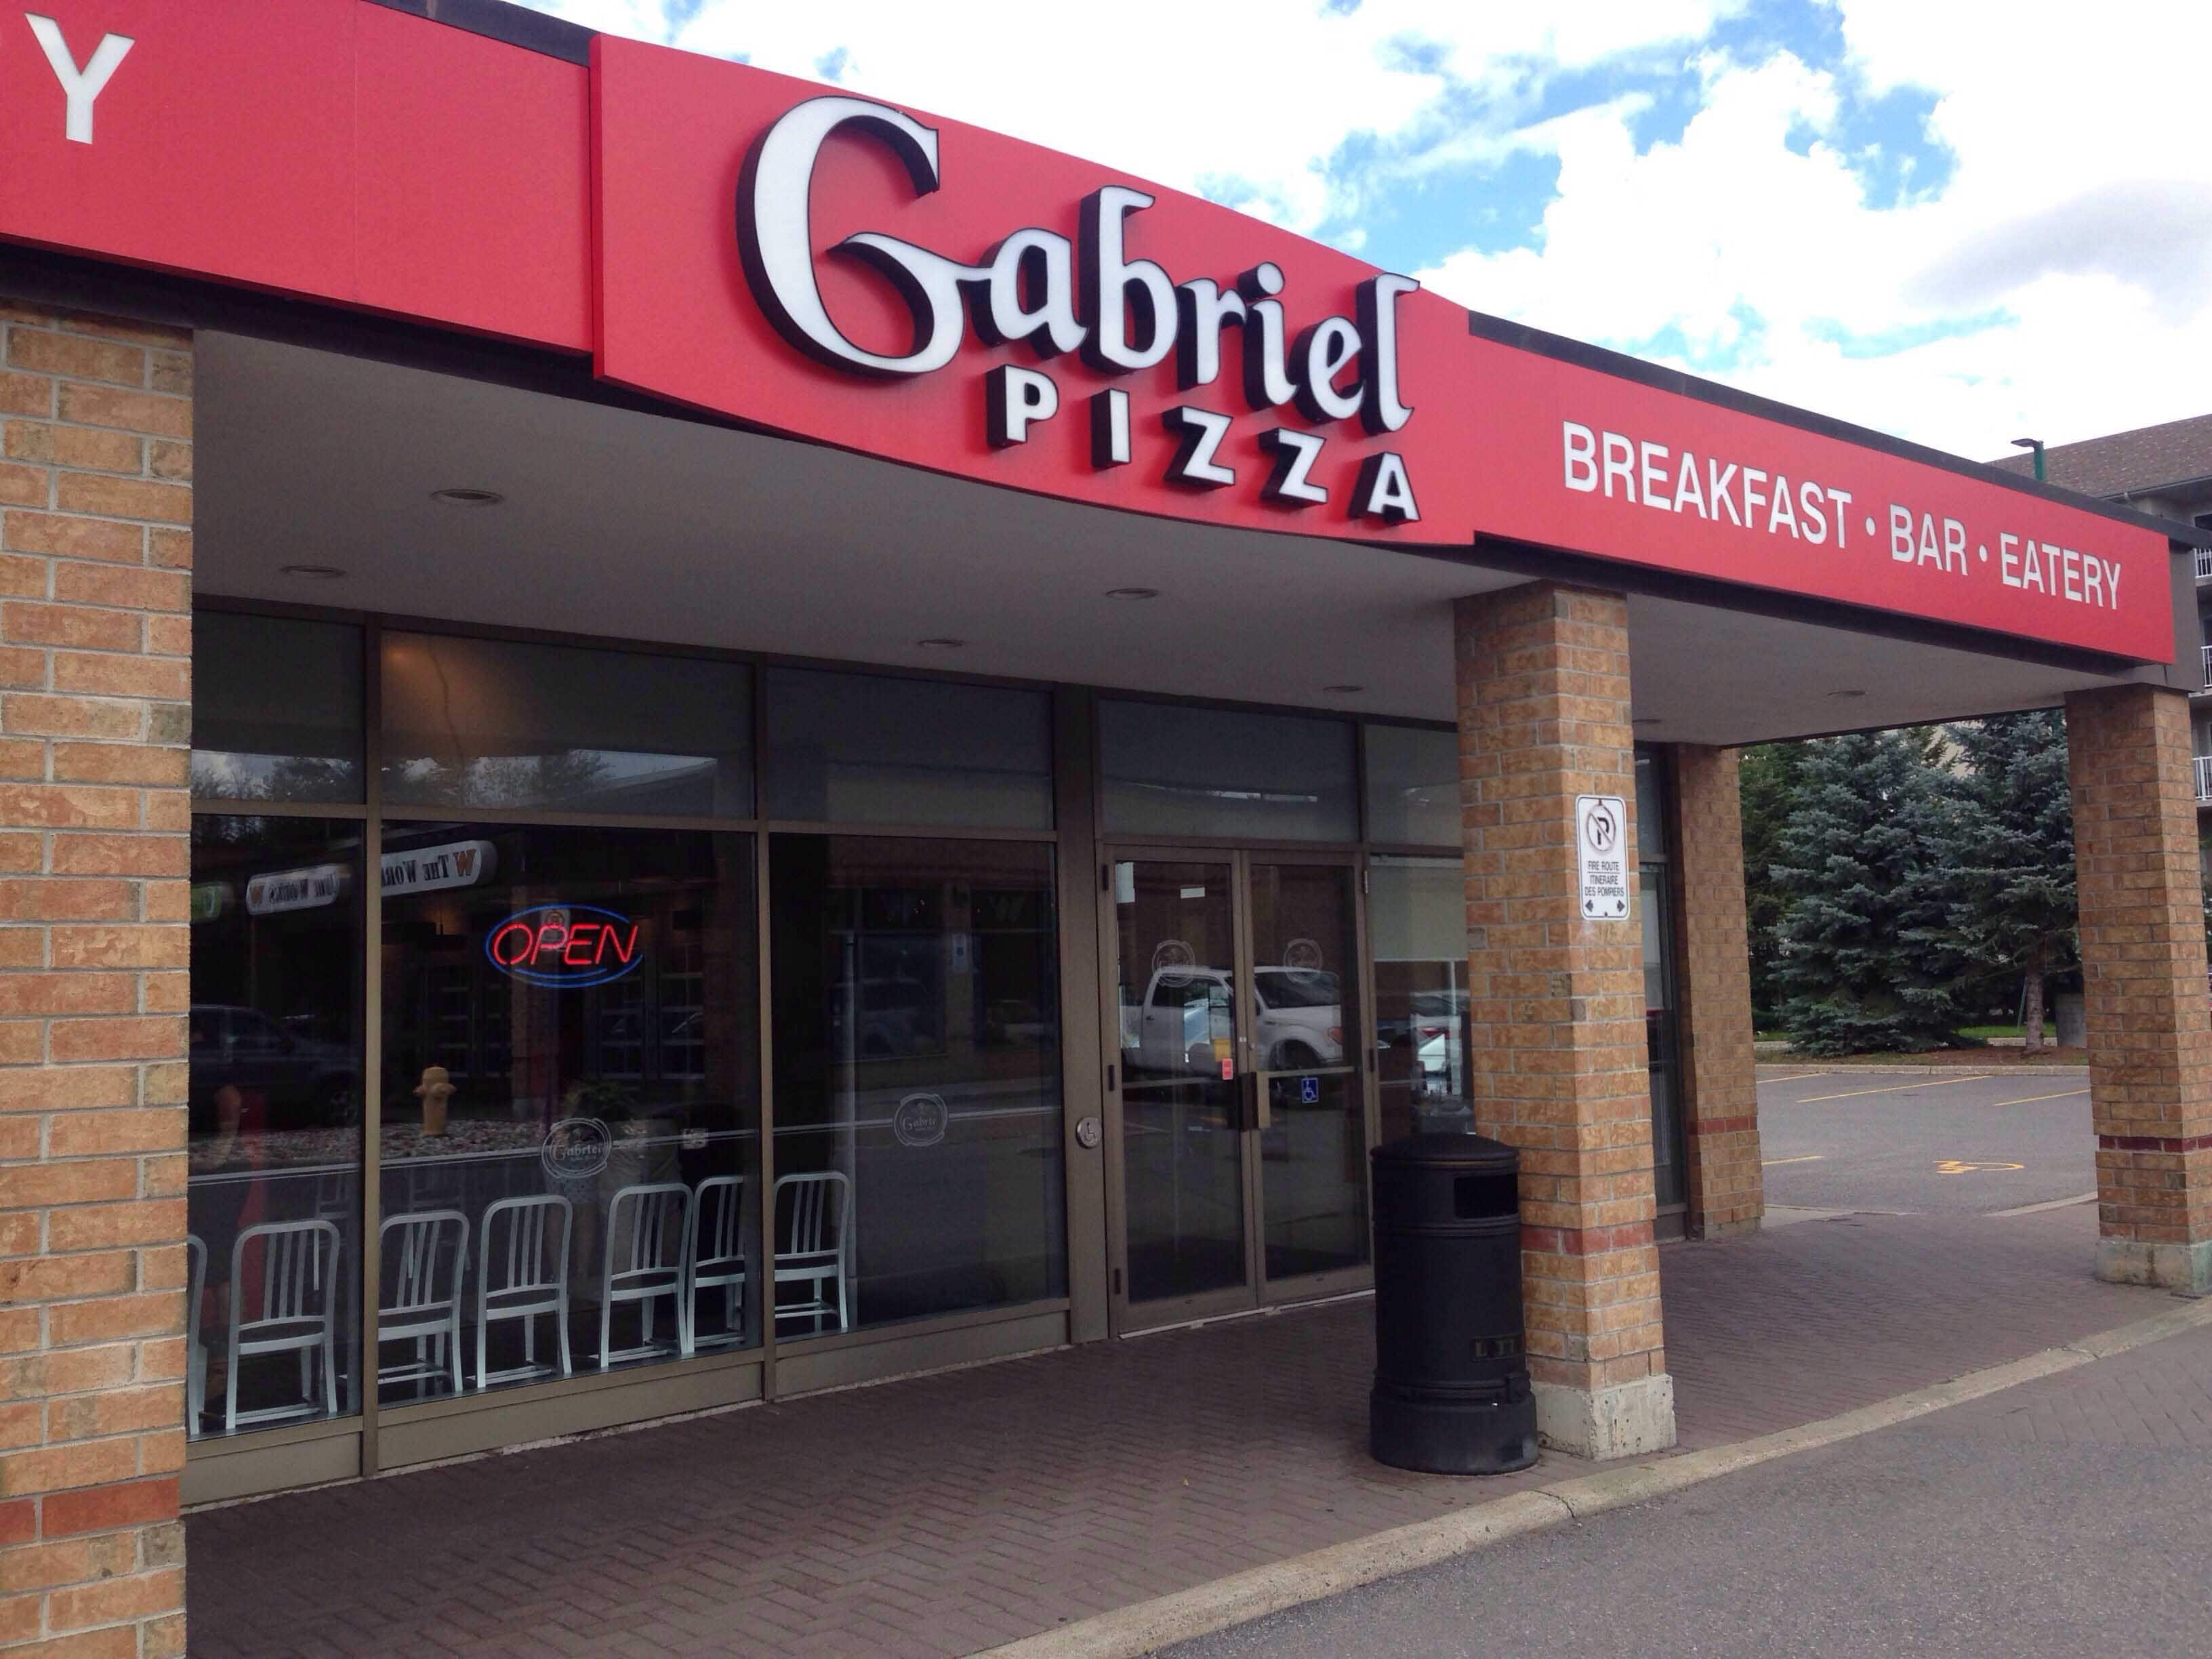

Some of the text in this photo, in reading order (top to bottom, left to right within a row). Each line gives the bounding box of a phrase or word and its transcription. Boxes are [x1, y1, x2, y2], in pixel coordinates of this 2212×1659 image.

[24, 10, 136, 145] Y
[737, 94, 1420, 435] Gabriel
[987, 363, 1420, 525] PIZZA
[1562, 420, 2121, 611] BREAKFAST BAR EATERY
[1584, 886, 1624, 897] DES POMPIERS
[1589, 861, 1619, 871] FIRE ROUTE
[492, 922, 639, 966] OPEN
